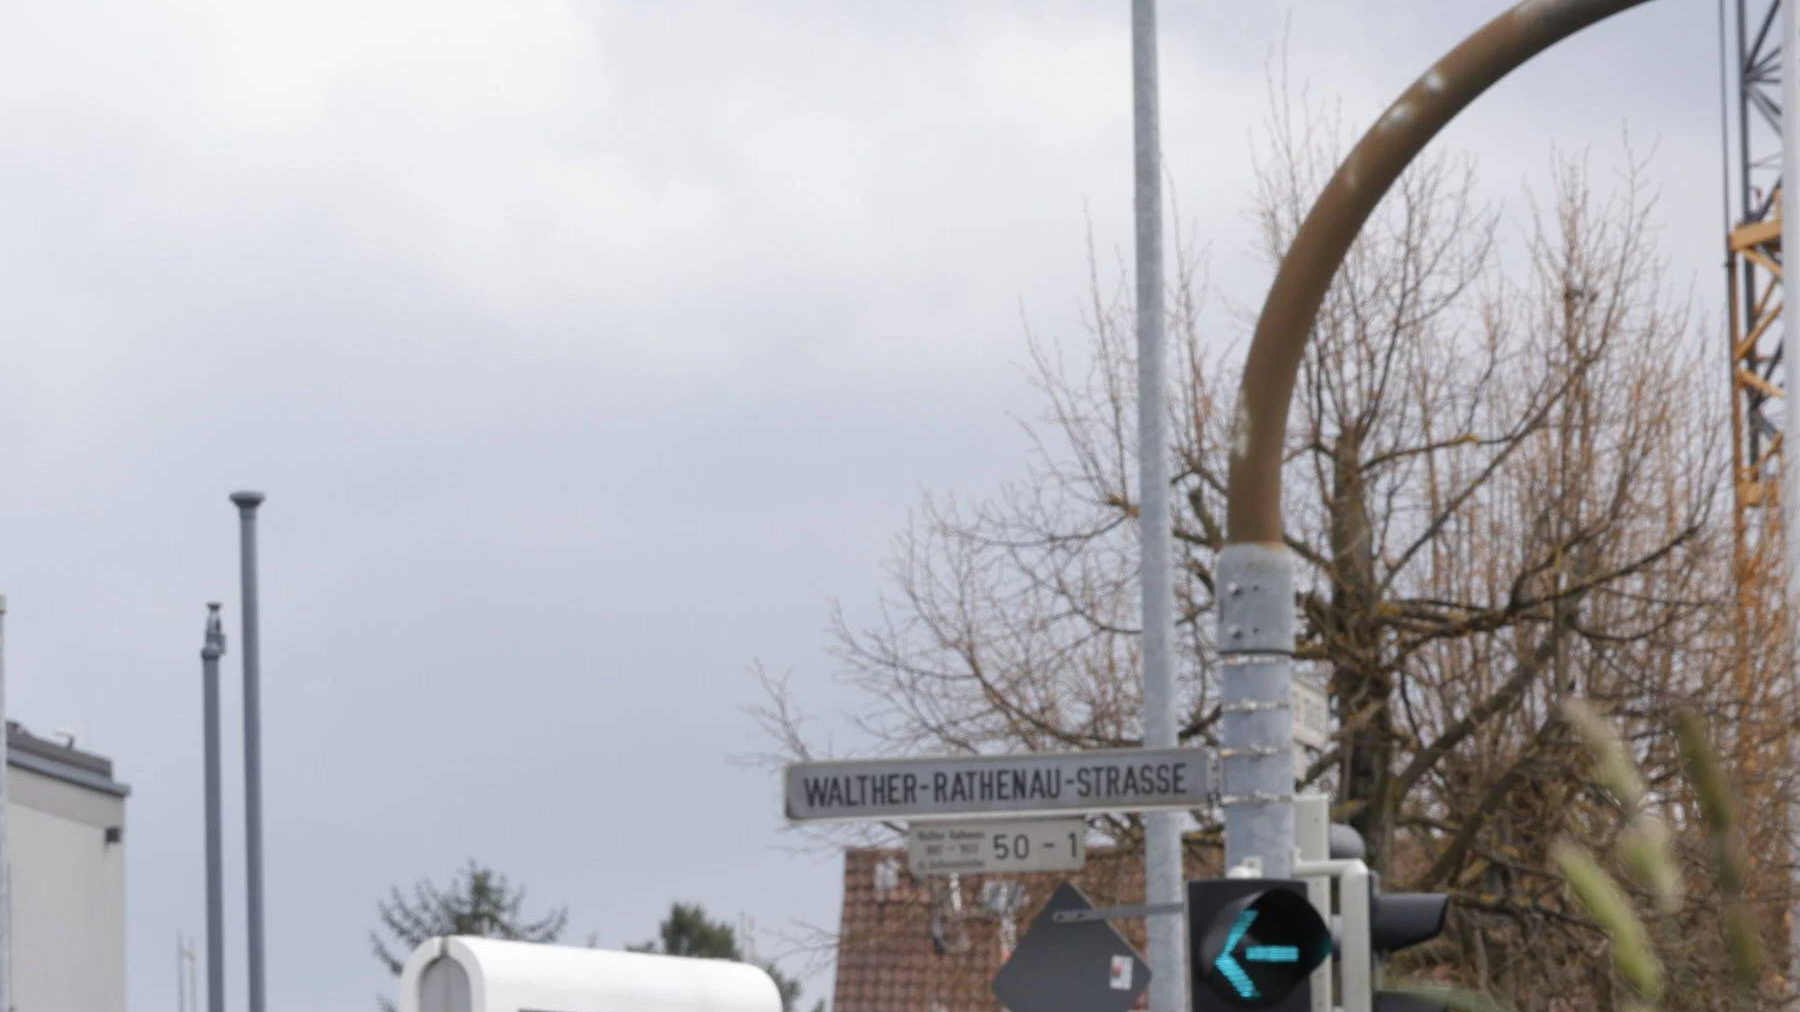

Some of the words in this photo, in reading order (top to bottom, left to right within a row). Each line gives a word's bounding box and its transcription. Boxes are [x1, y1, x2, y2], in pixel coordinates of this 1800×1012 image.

[803, 761, 1188, 808] WALTHER-RATHENAU-STRASSE
[993, 832, 1030, 861] 50
[1067, 831, 1078, 859] 1
